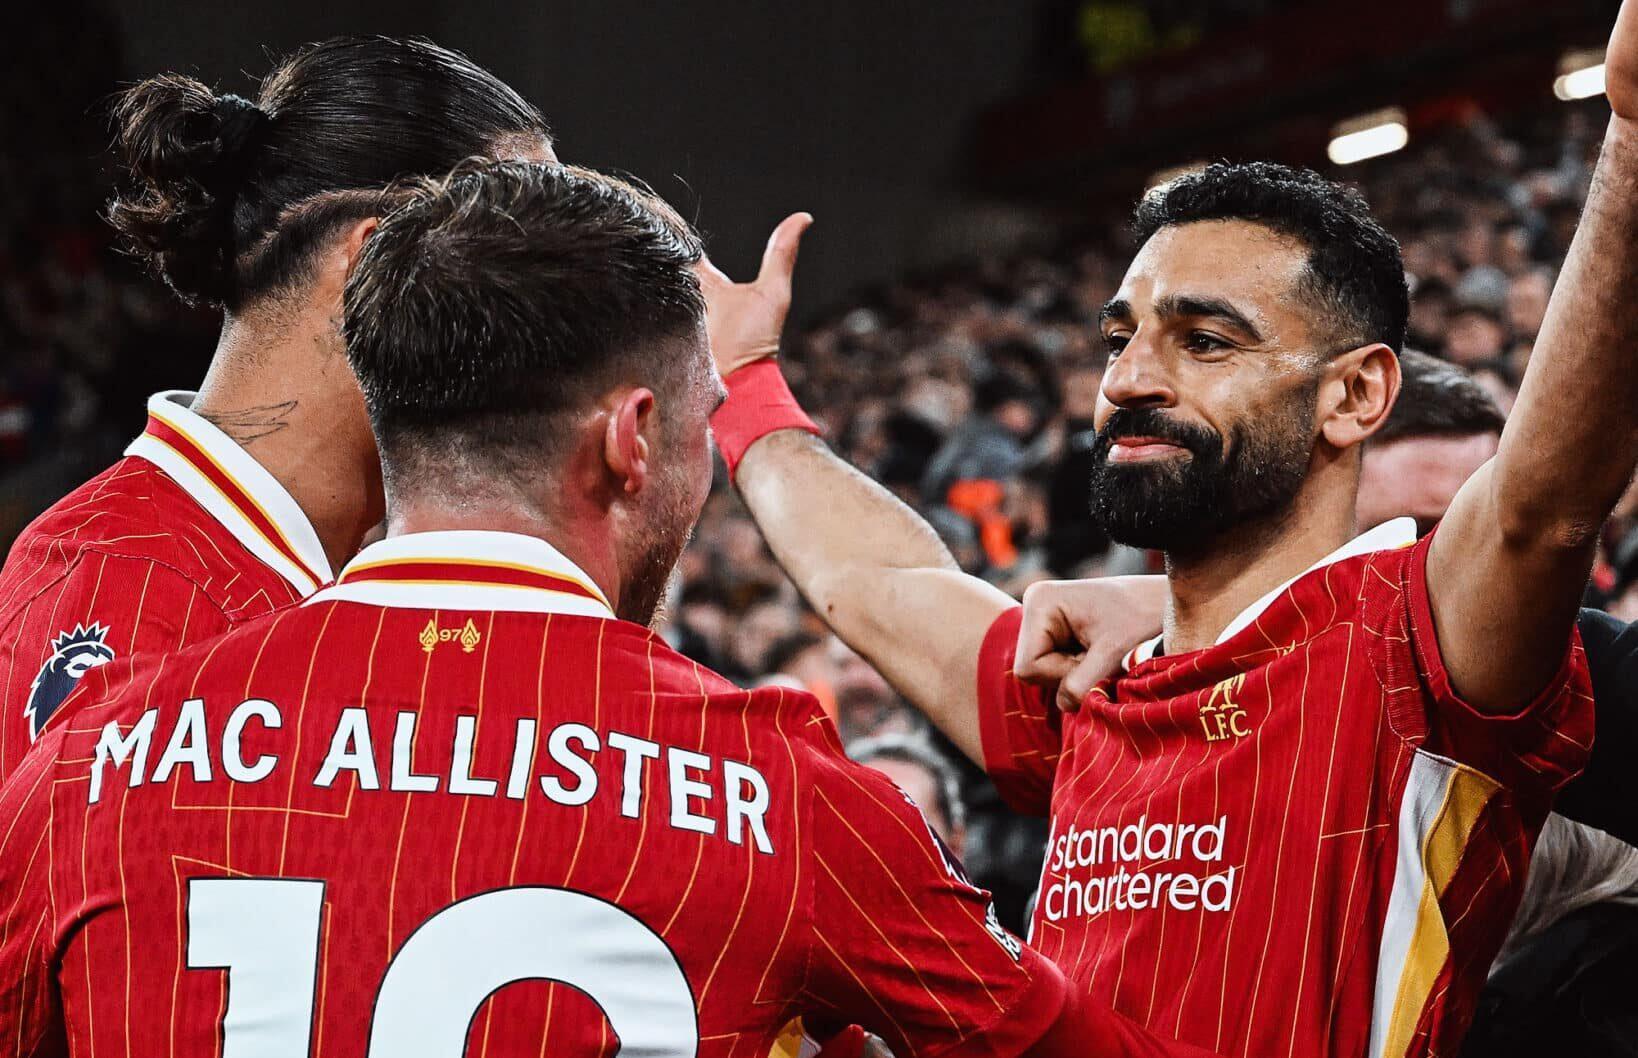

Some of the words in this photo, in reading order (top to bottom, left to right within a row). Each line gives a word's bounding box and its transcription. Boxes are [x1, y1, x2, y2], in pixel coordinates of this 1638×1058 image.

[440, 628, 462, 642] 97
[88, 698, 282, 804] MAC
[313, 705, 775, 855] ALLISTER
[1050, 814, 1227, 872] standard
[1044, 864, 1235, 921] chartered
